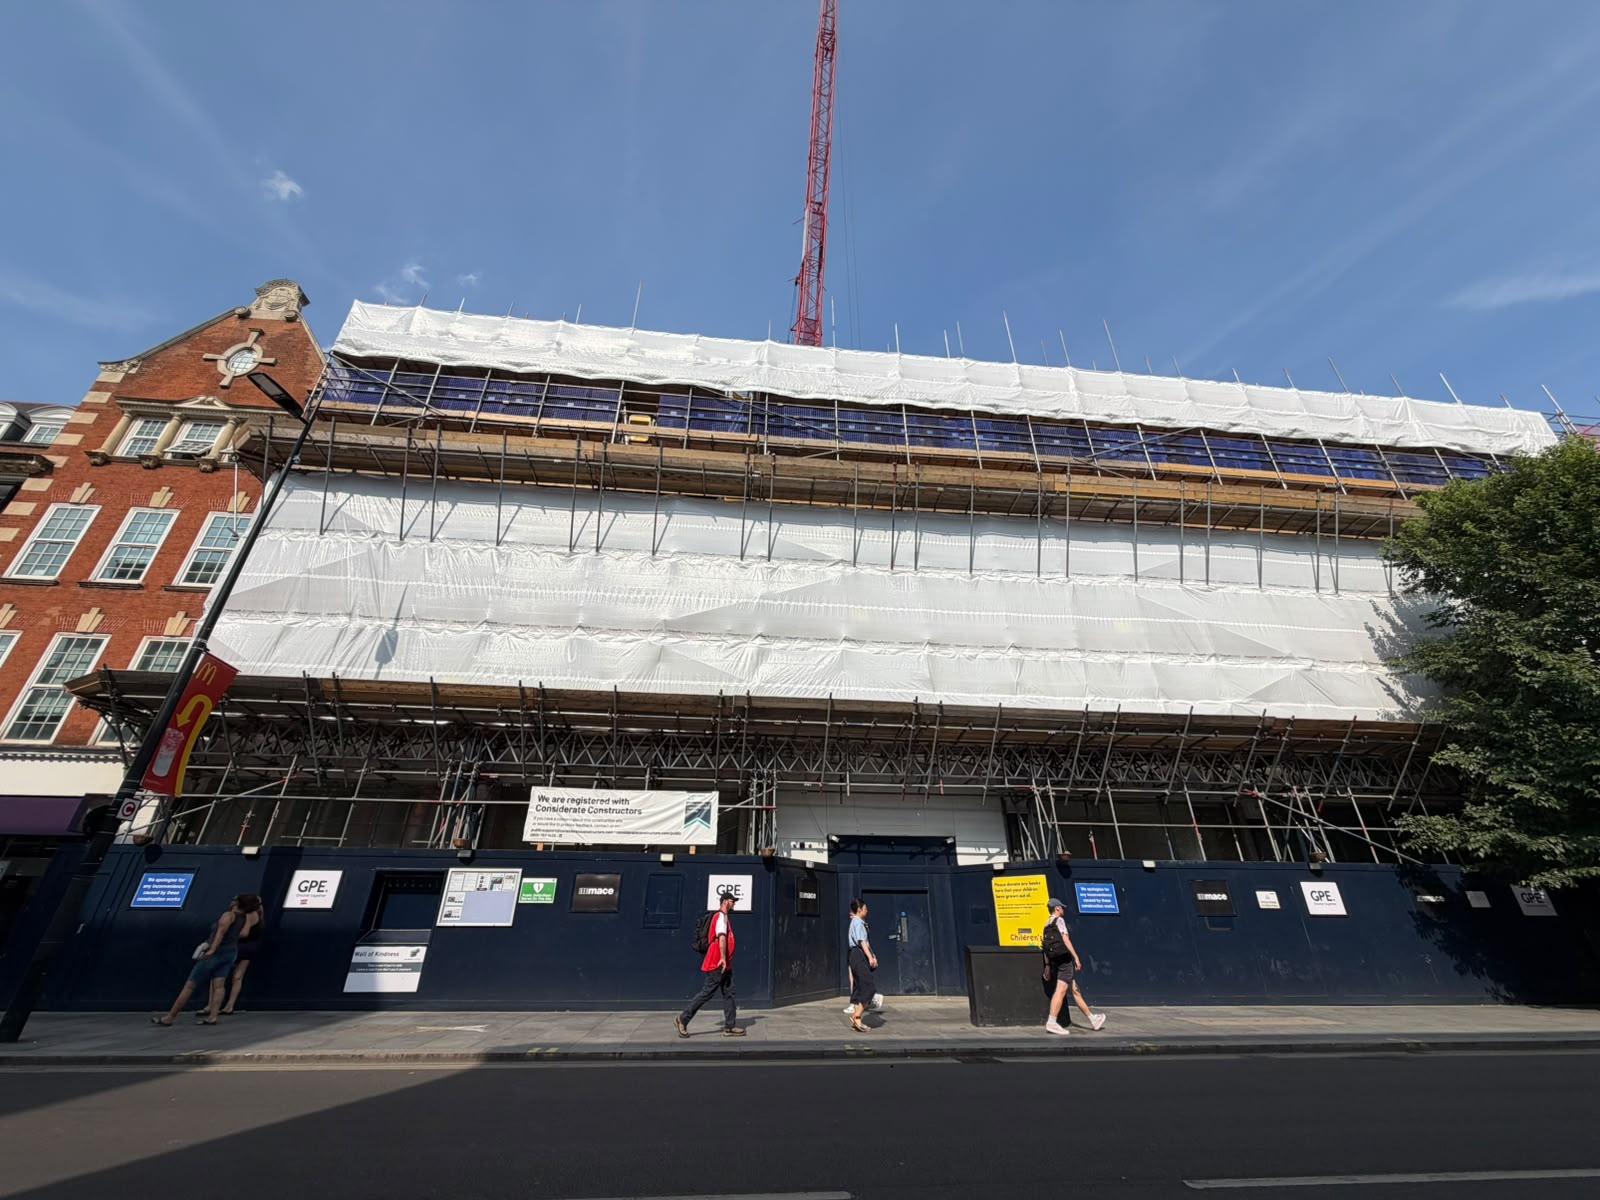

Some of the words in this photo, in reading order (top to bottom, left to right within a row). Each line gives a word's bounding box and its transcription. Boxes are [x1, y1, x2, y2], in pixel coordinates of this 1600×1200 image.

[566, 796, 610, 805] registered
[612, 797, 630, 805] with
[536, 804, 586, 814] Considerate
[588, 806, 642, 814] Constructors
